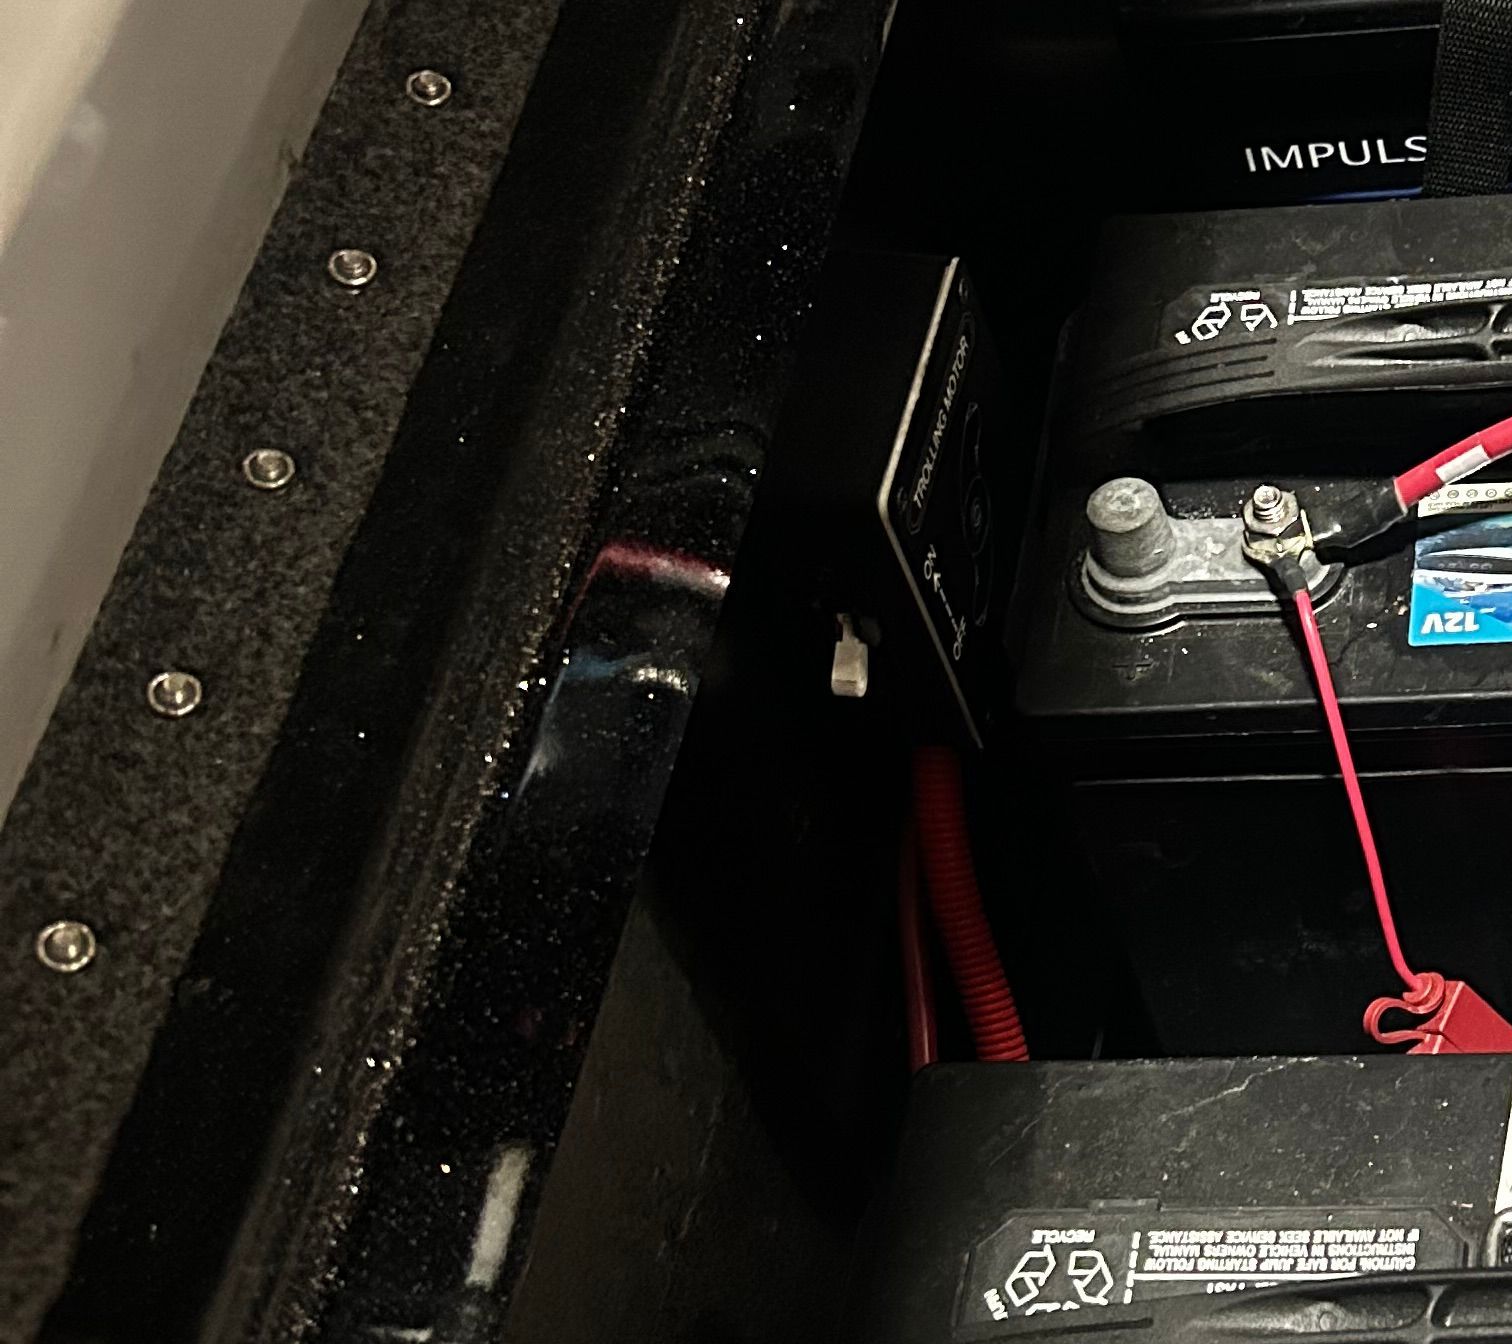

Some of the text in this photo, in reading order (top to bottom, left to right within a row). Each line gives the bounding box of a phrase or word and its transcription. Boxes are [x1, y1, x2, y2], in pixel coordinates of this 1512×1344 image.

[1244, 136, 1428, 173] IMPULS
[1210, 291, 1261, 304] RECYCLE
[913, 335, 970, 509] TROLLING MOTOR
[923, 543, 938, 581] ON
[1420, 611, 1480, 634] 12V
[952, 614, 968, 661] OFF
[1031, 1229, 1096, 1244] RECYCLE
[1224, 1230, 1278, 1244] SERVICE
[1280, 1230, 1311, 1244] SEEK
[1313, 1229, 1377, 1244] AVAILABLE
[1379, 1229, 1405, 1243] NOT
[1407, 1229, 1420, 1243] IF
[1203, 1244, 1257, 1258] OWNERS
[1257, 1244, 1310, 1258] VEHICLE
[1310, 1243, 1327, 1257] IN
[1327, 1243, 1416, 1257] INSTRUCTIONS
[1144, 1257, 1196, 1272] FOLLOW
[1197, 1257, 1258, 1272] STARTING
[1259, 1257, 1295, 1271] JUMP
[1296, 1257, 1328, 1271] SAFE
[1331, 1257, 1357, 1271] FOR
